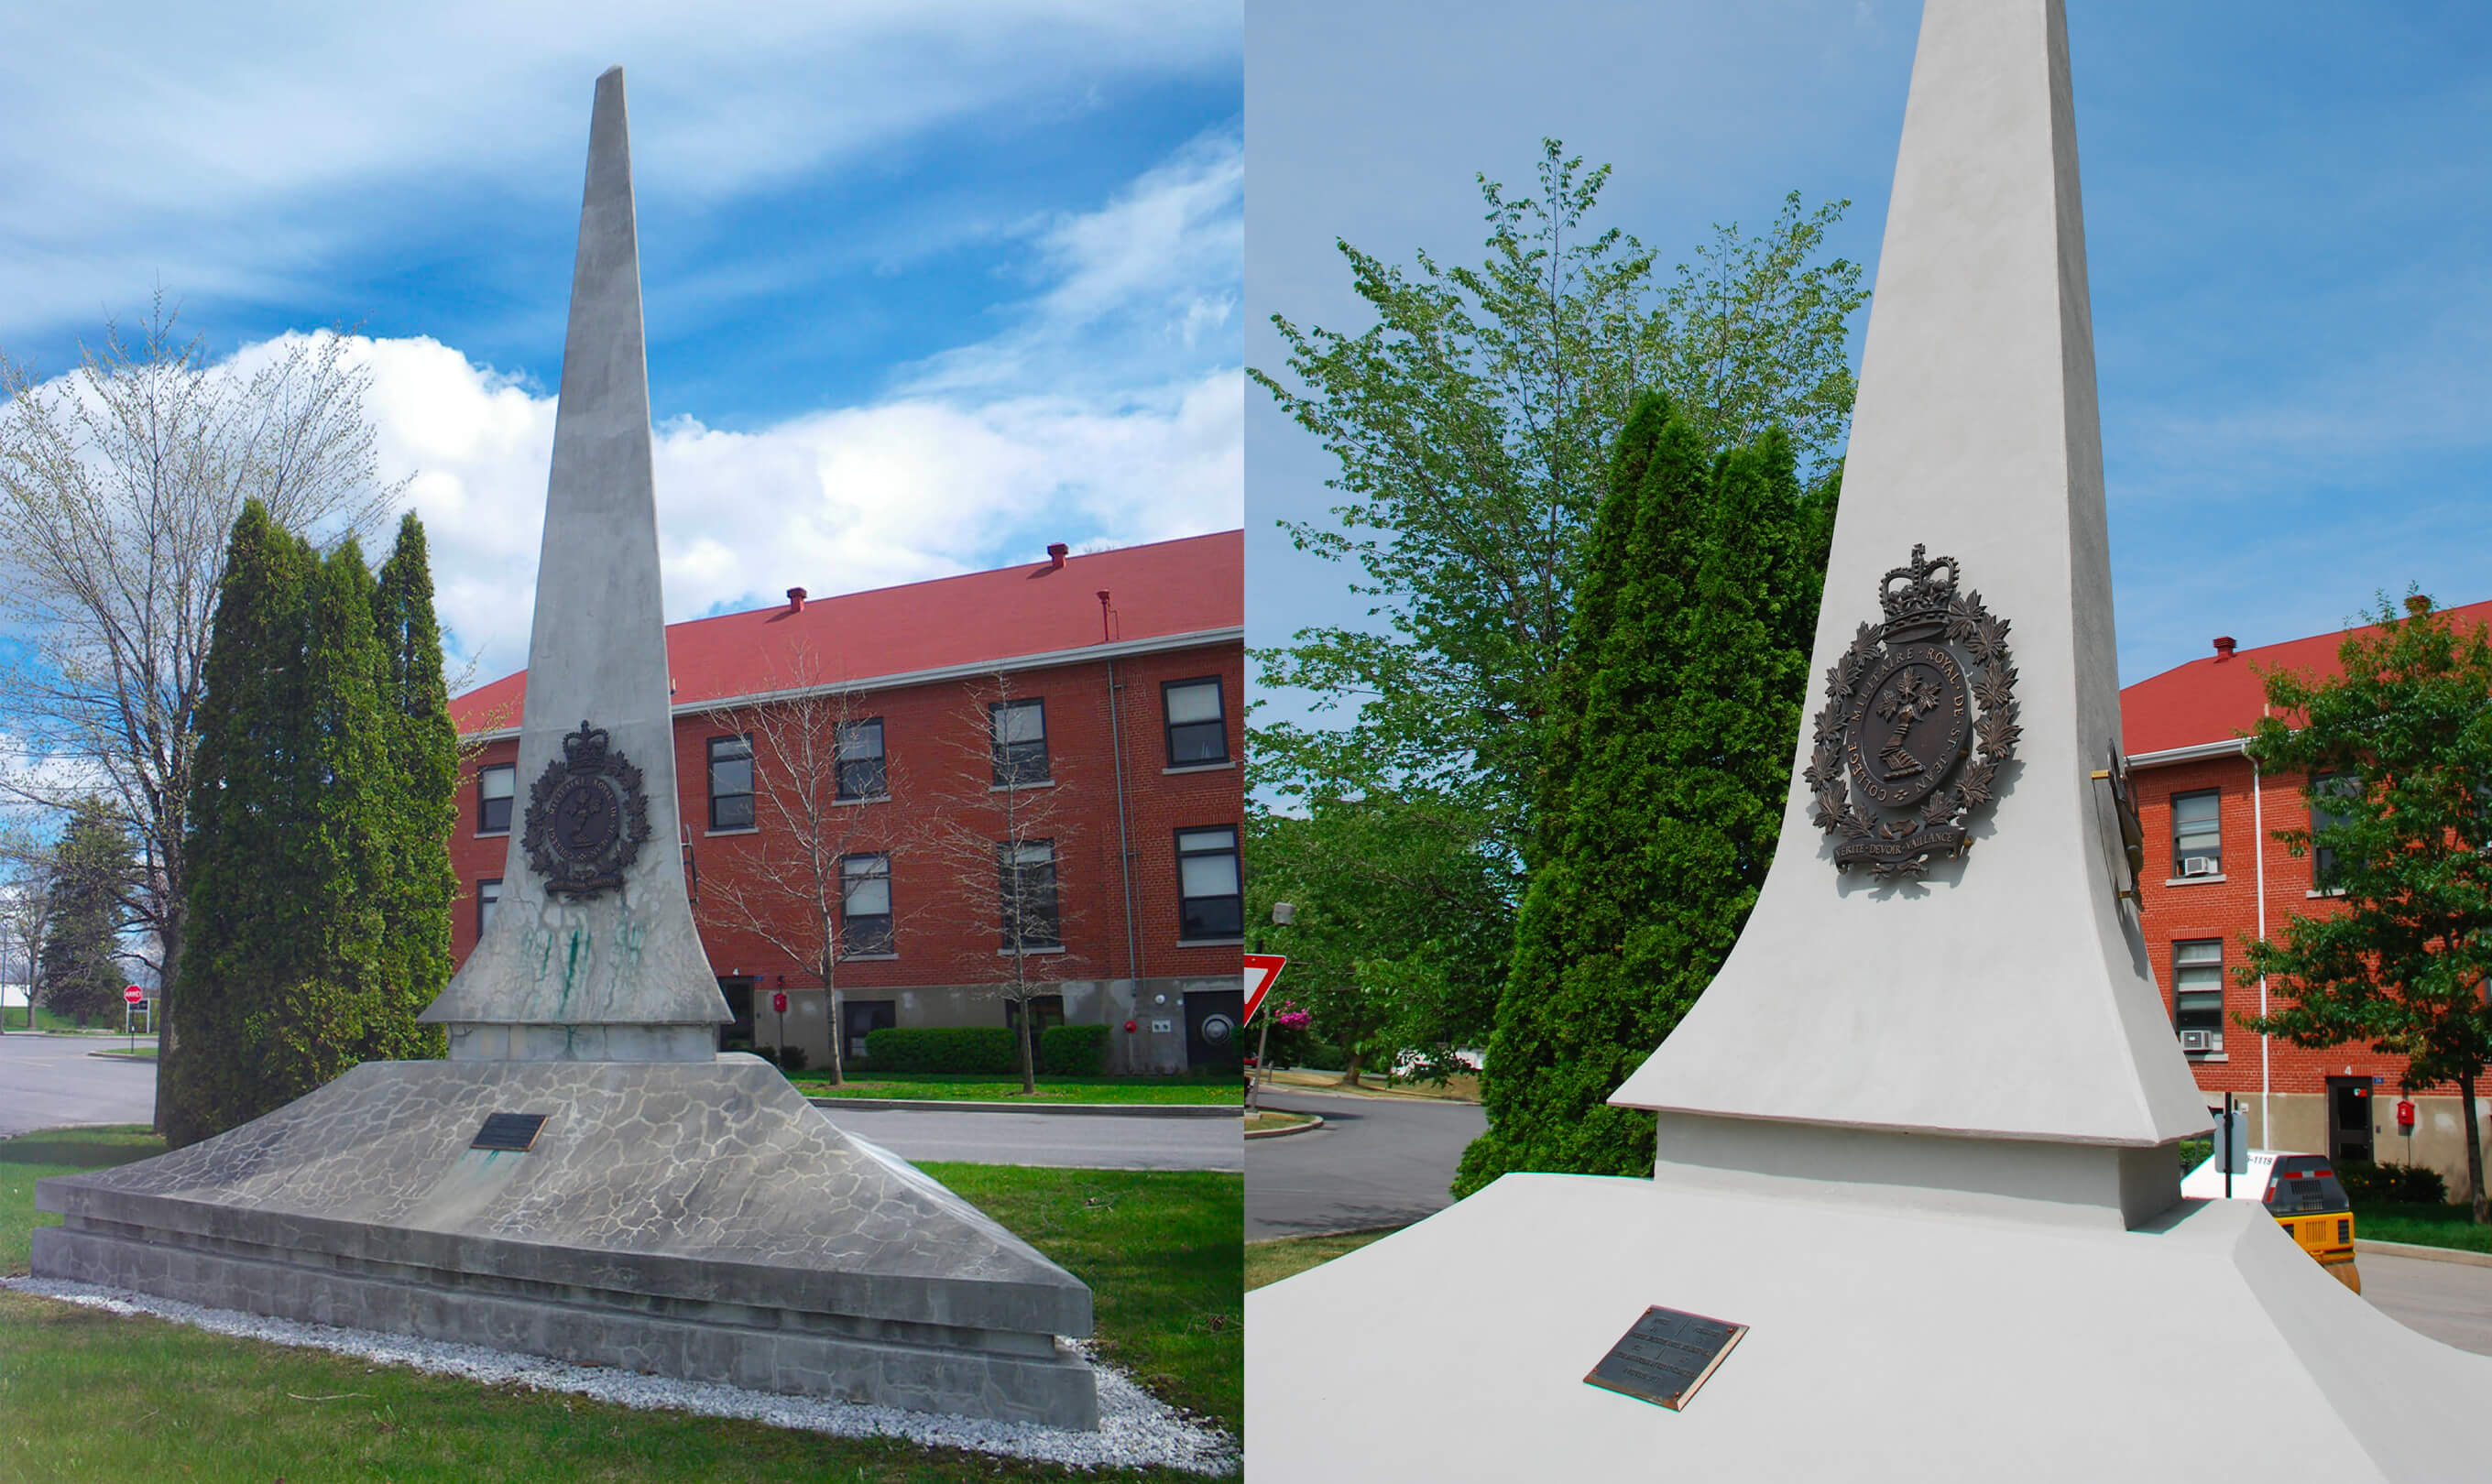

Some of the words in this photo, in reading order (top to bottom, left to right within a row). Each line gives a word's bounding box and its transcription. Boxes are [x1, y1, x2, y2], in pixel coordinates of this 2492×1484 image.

[1926, 648, 1959, 684] ROYAL
[1852, 648, 1914, 722] MILITAIRE
[1953, 695, 1964, 718] DE
[1915, 753, 1949, 792] JEAN
[1869, 844, 1902, 856] DEVOIR
[1906, 832, 1953, 850] VAILLANCE
[2344, 1064, 2352, 1075] 4
